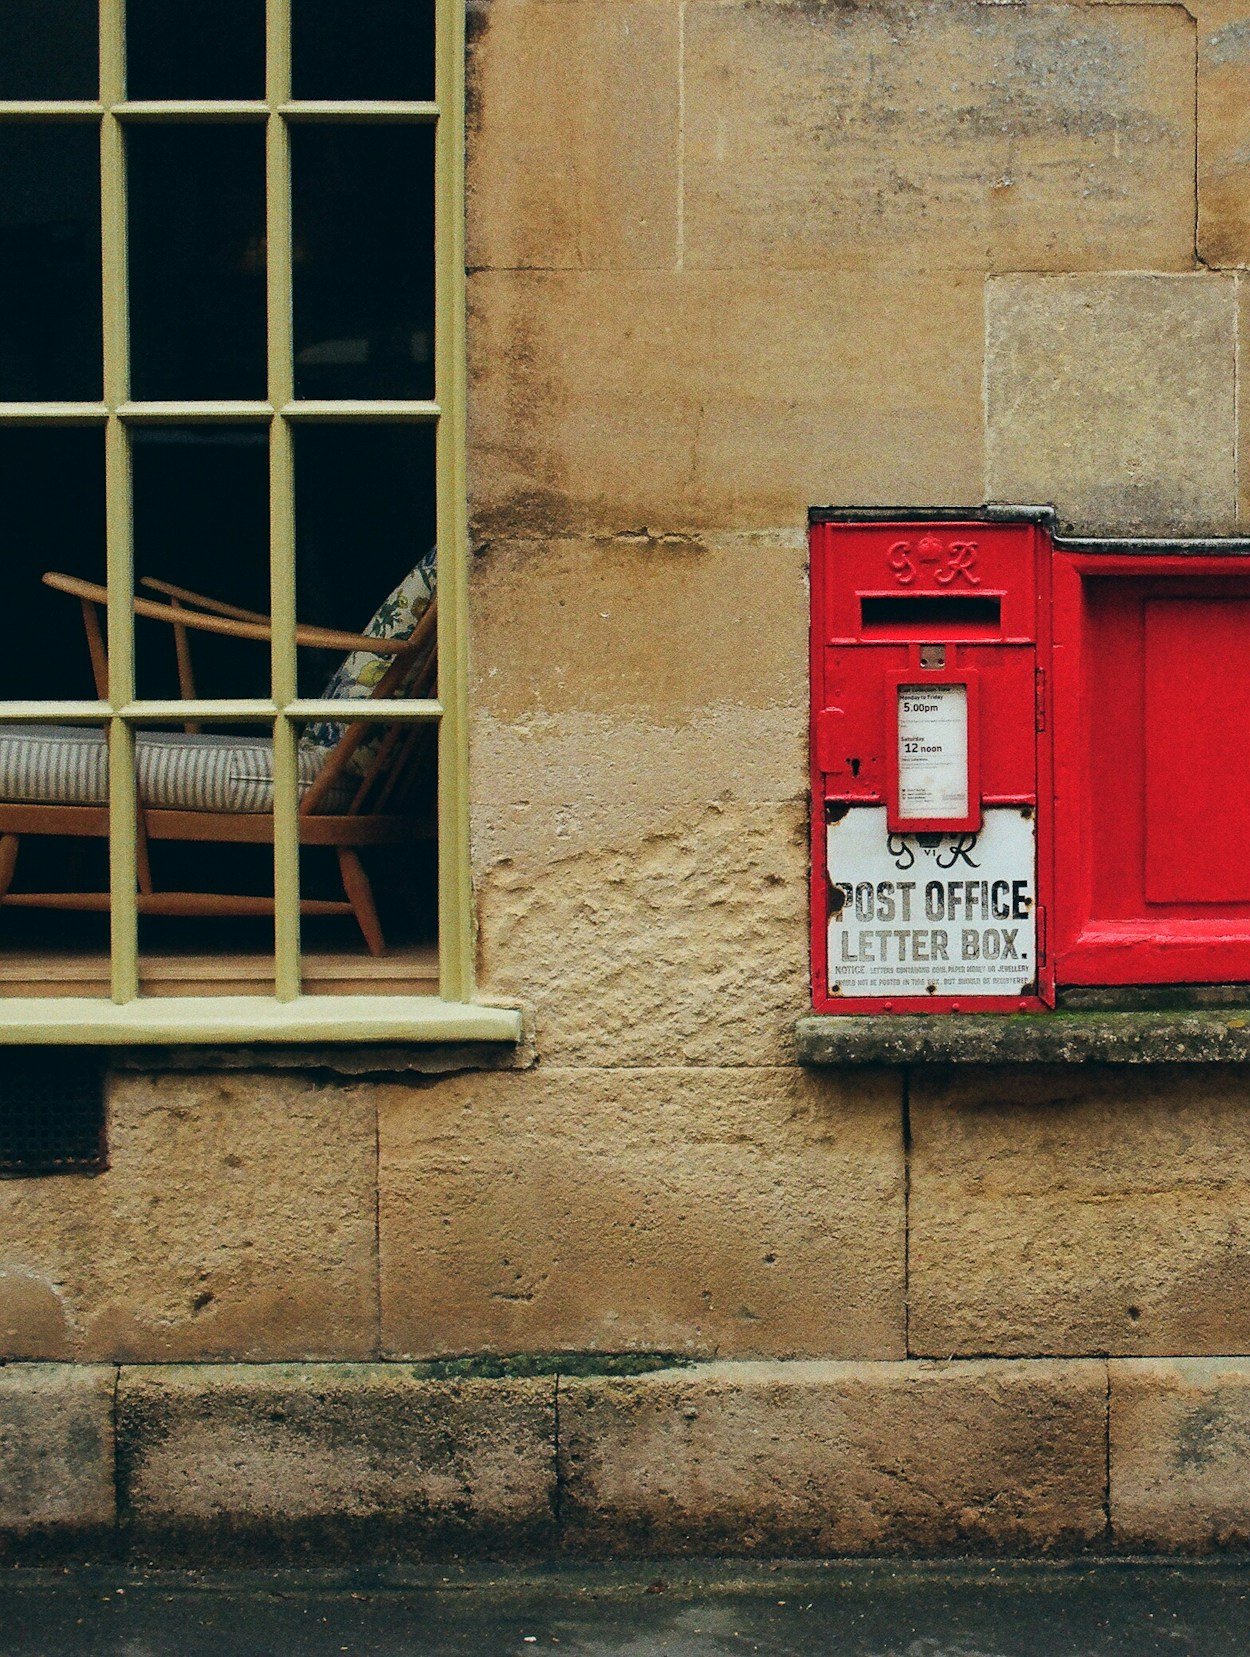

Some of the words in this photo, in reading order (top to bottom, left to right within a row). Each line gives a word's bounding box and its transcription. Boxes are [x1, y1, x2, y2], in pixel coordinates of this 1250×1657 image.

[934, 541, 980, 584] R
[904, 702, 939, 713] 5.00pm
[904, 743, 919, 753] 12
[936, 832, 982, 869] R
[836, 881, 916, 922] POST
[925, 880, 1029, 921] OFFICE
[841, 930, 949, 962] LETTER
[961, 928, 1028, 961] BOX.
[835, 966, 865, 974] NOTICE
[896, 966, 930, 974] CONTAINING
[966, 965, 986, 973] MONEY
[988, 965, 996, 973] OR
[879, 978, 900, 986] POSTED
[958, 977, 980, 985] SHOULD
